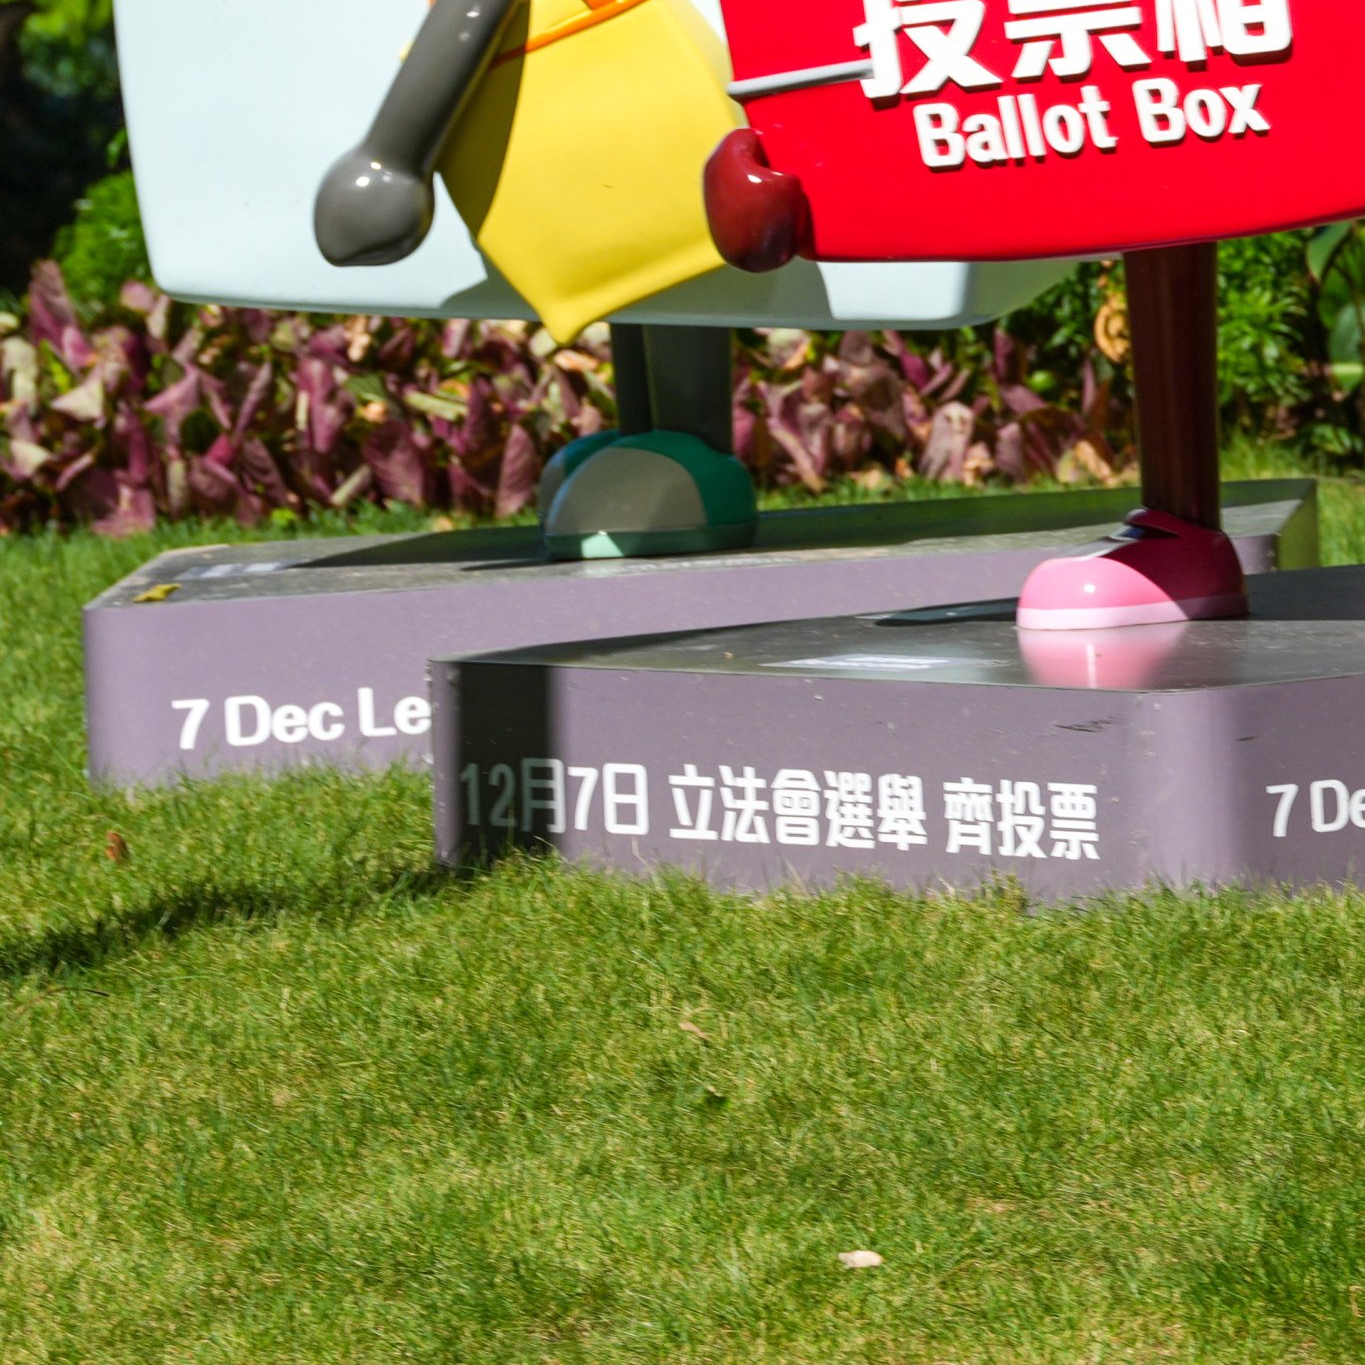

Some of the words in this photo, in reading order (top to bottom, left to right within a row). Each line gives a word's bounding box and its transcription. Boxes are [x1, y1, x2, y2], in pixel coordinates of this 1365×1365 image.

[913, 85, 1118, 169] Ballot
[1131, 77, 1271, 144] Box
[171, 699, 210, 750] 7
[224, 695, 345, 747] Dec
[460, 757, 650, 836] 12月7日
[668, 764, 928, 852] 立法會選舉
[943, 777, 1101, 861] 齊投票
[1266, 782, 1298, 837] 7
